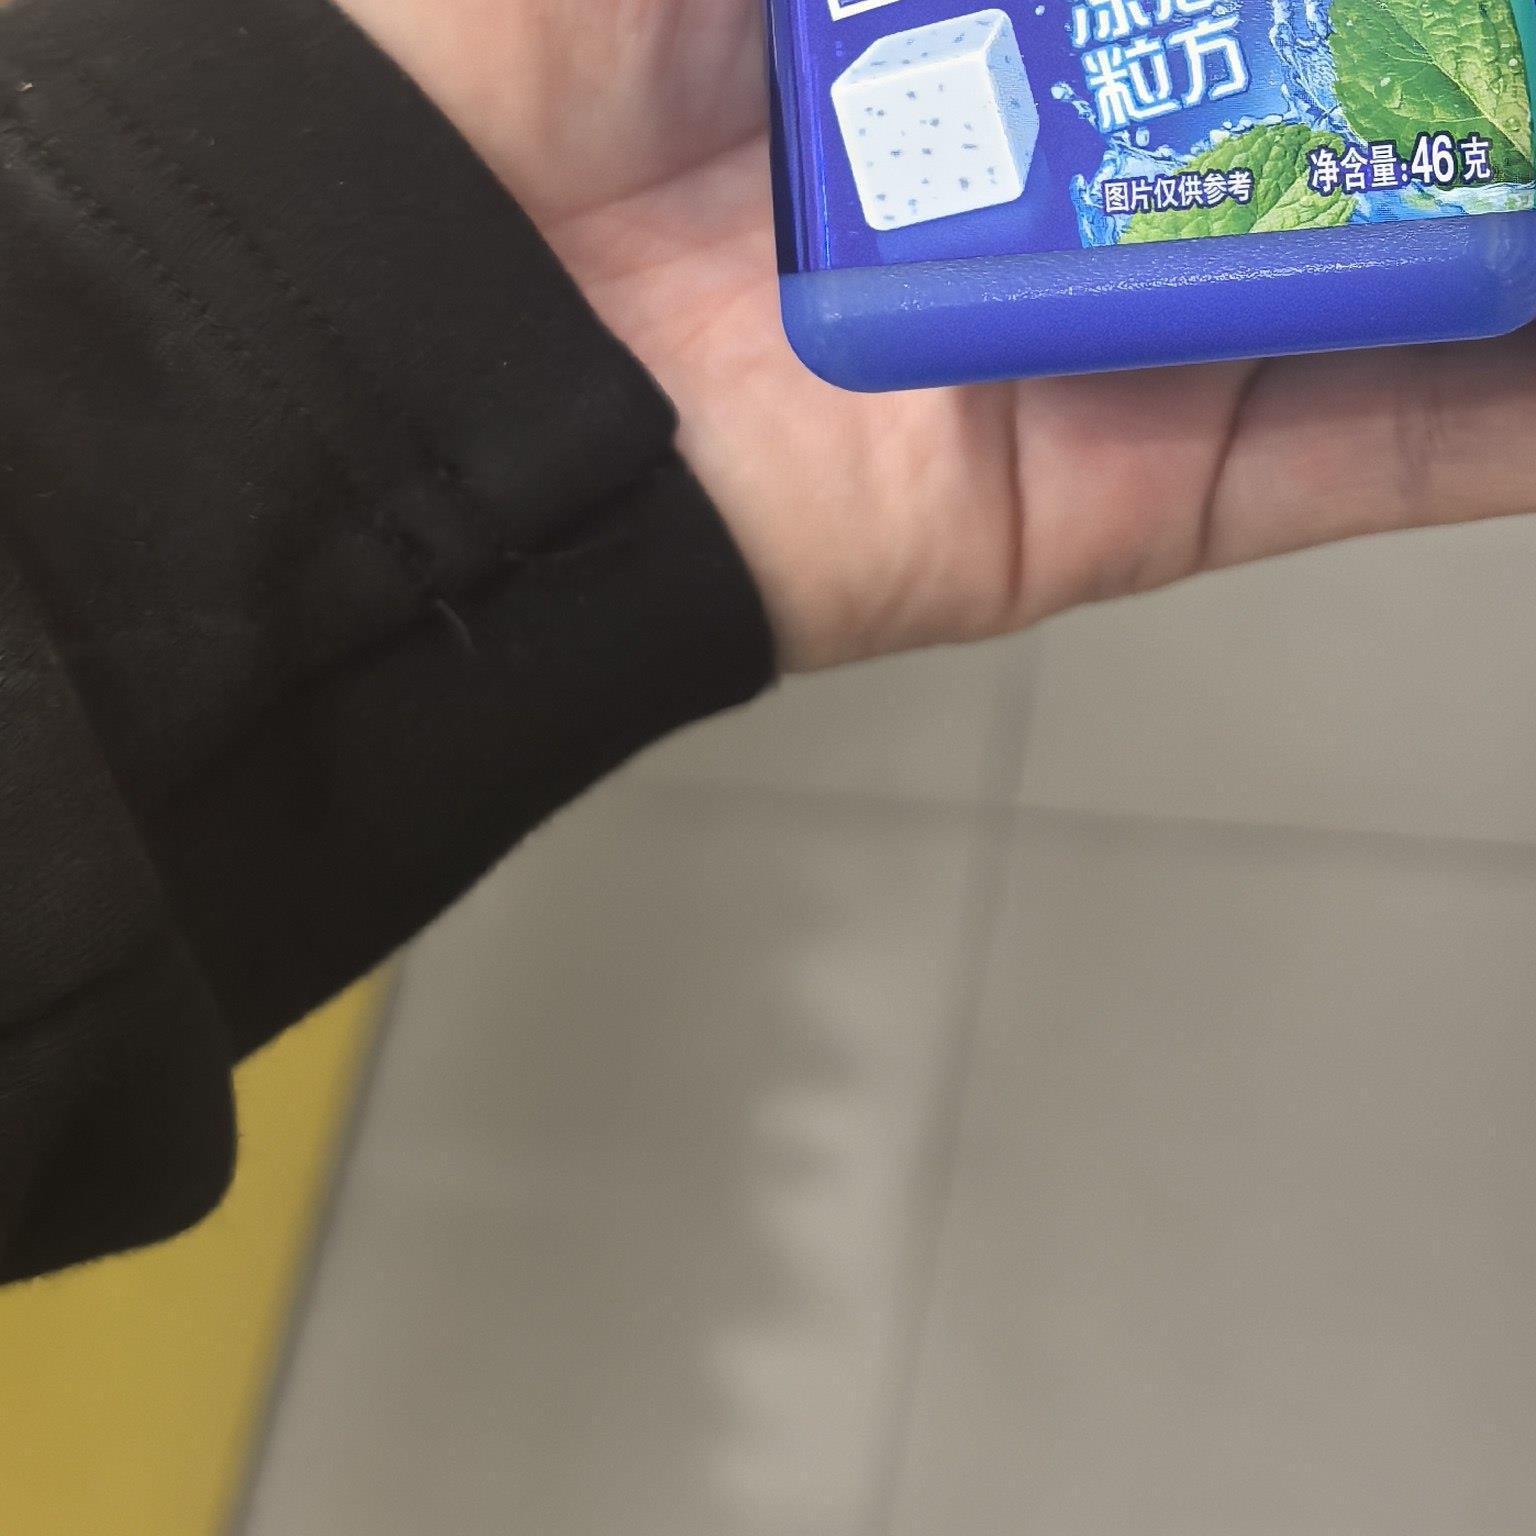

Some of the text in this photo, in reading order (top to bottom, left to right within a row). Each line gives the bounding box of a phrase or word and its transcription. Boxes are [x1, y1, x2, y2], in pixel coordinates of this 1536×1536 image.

[1083, 12, 1250, 131] 粒方
[1104, 174, 1250, 212] 图片仅供参考
